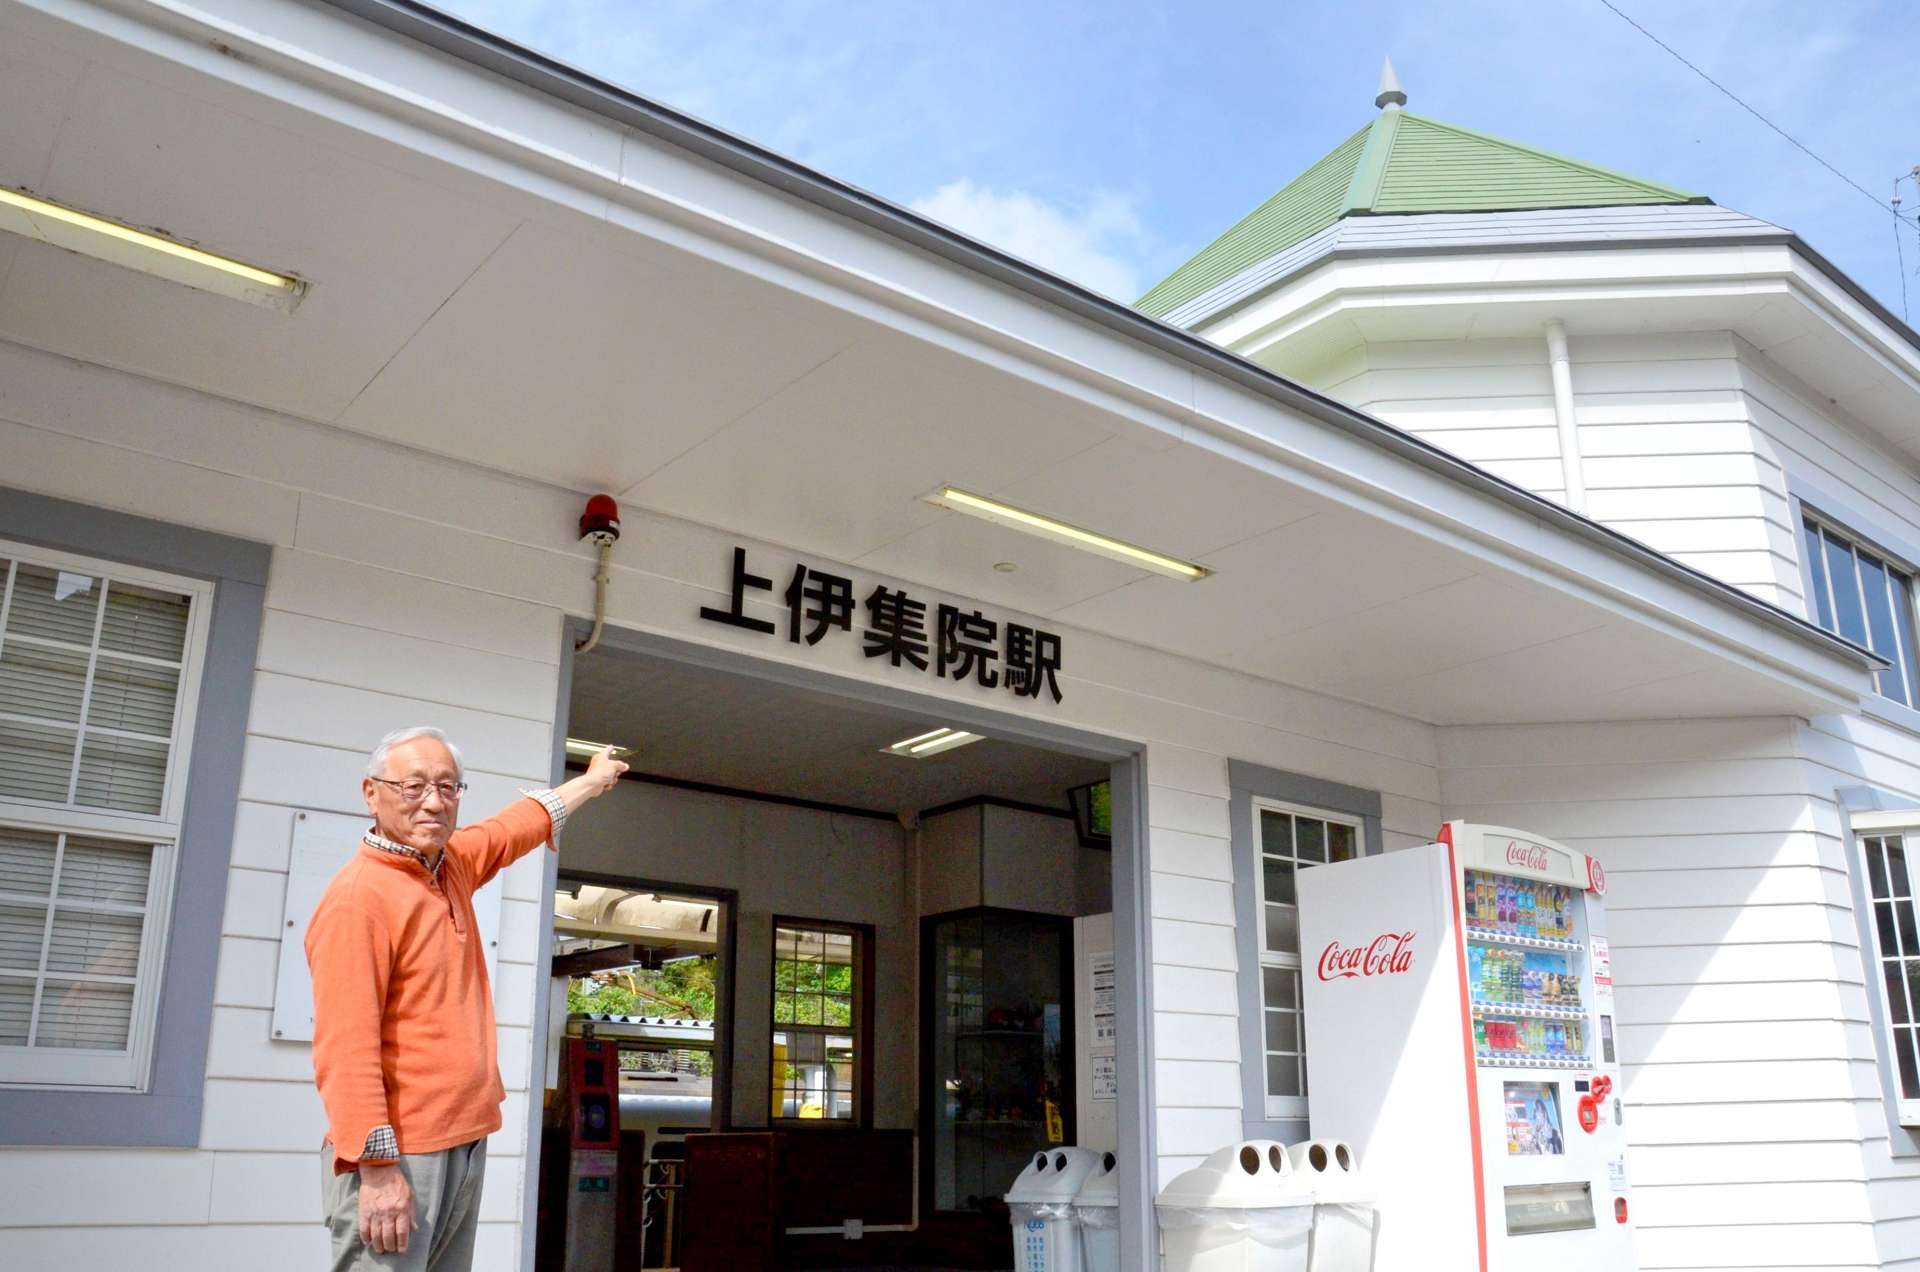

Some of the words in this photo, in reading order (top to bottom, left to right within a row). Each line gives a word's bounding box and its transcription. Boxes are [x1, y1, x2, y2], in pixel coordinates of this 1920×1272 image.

[700, 547, 1063, 705] 上伊集院駅
[1318, 931, 1416, 982] Coca-Cola
